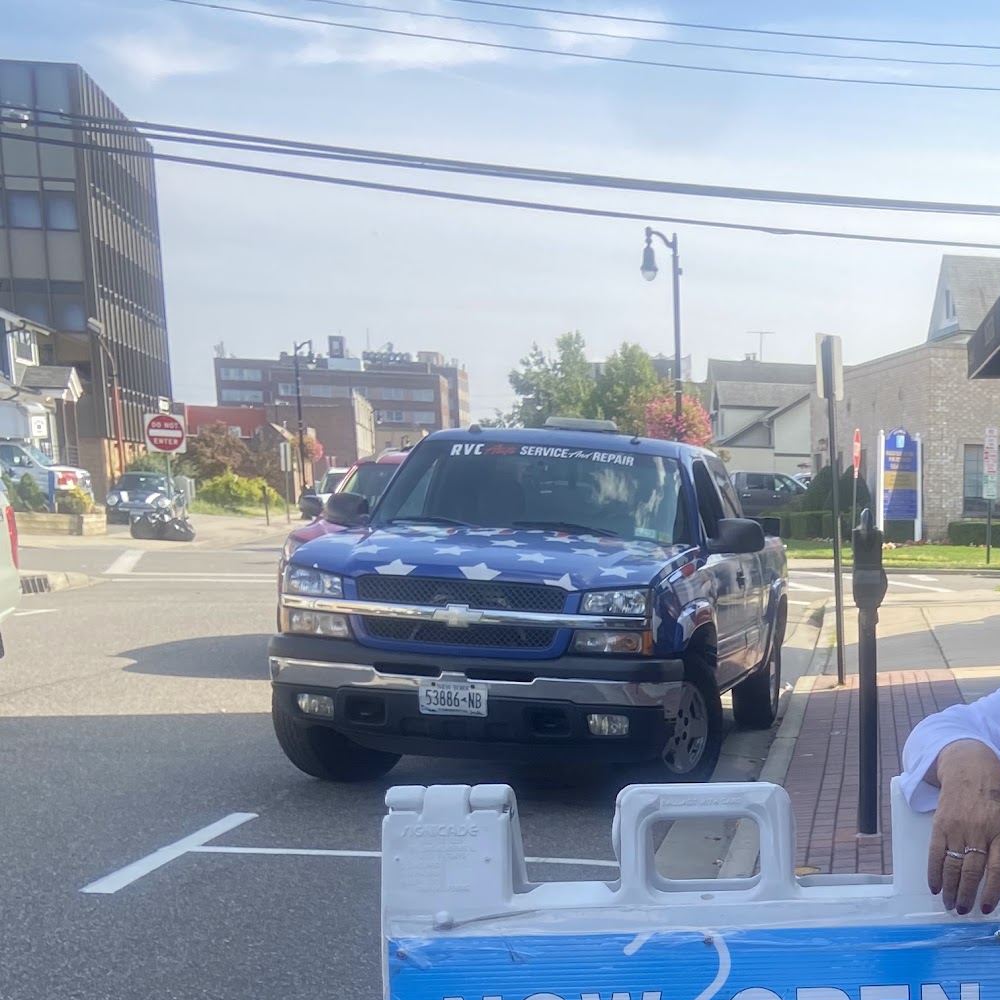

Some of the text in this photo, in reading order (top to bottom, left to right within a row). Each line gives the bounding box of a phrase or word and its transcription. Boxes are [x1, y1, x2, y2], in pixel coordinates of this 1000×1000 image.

[153, 437, 179, 445] ENTER
[450, 443, 485, 456] RVC
[519, 445, 569, 459] SERVICE
[592, 451, 635, 467] REPAIR
